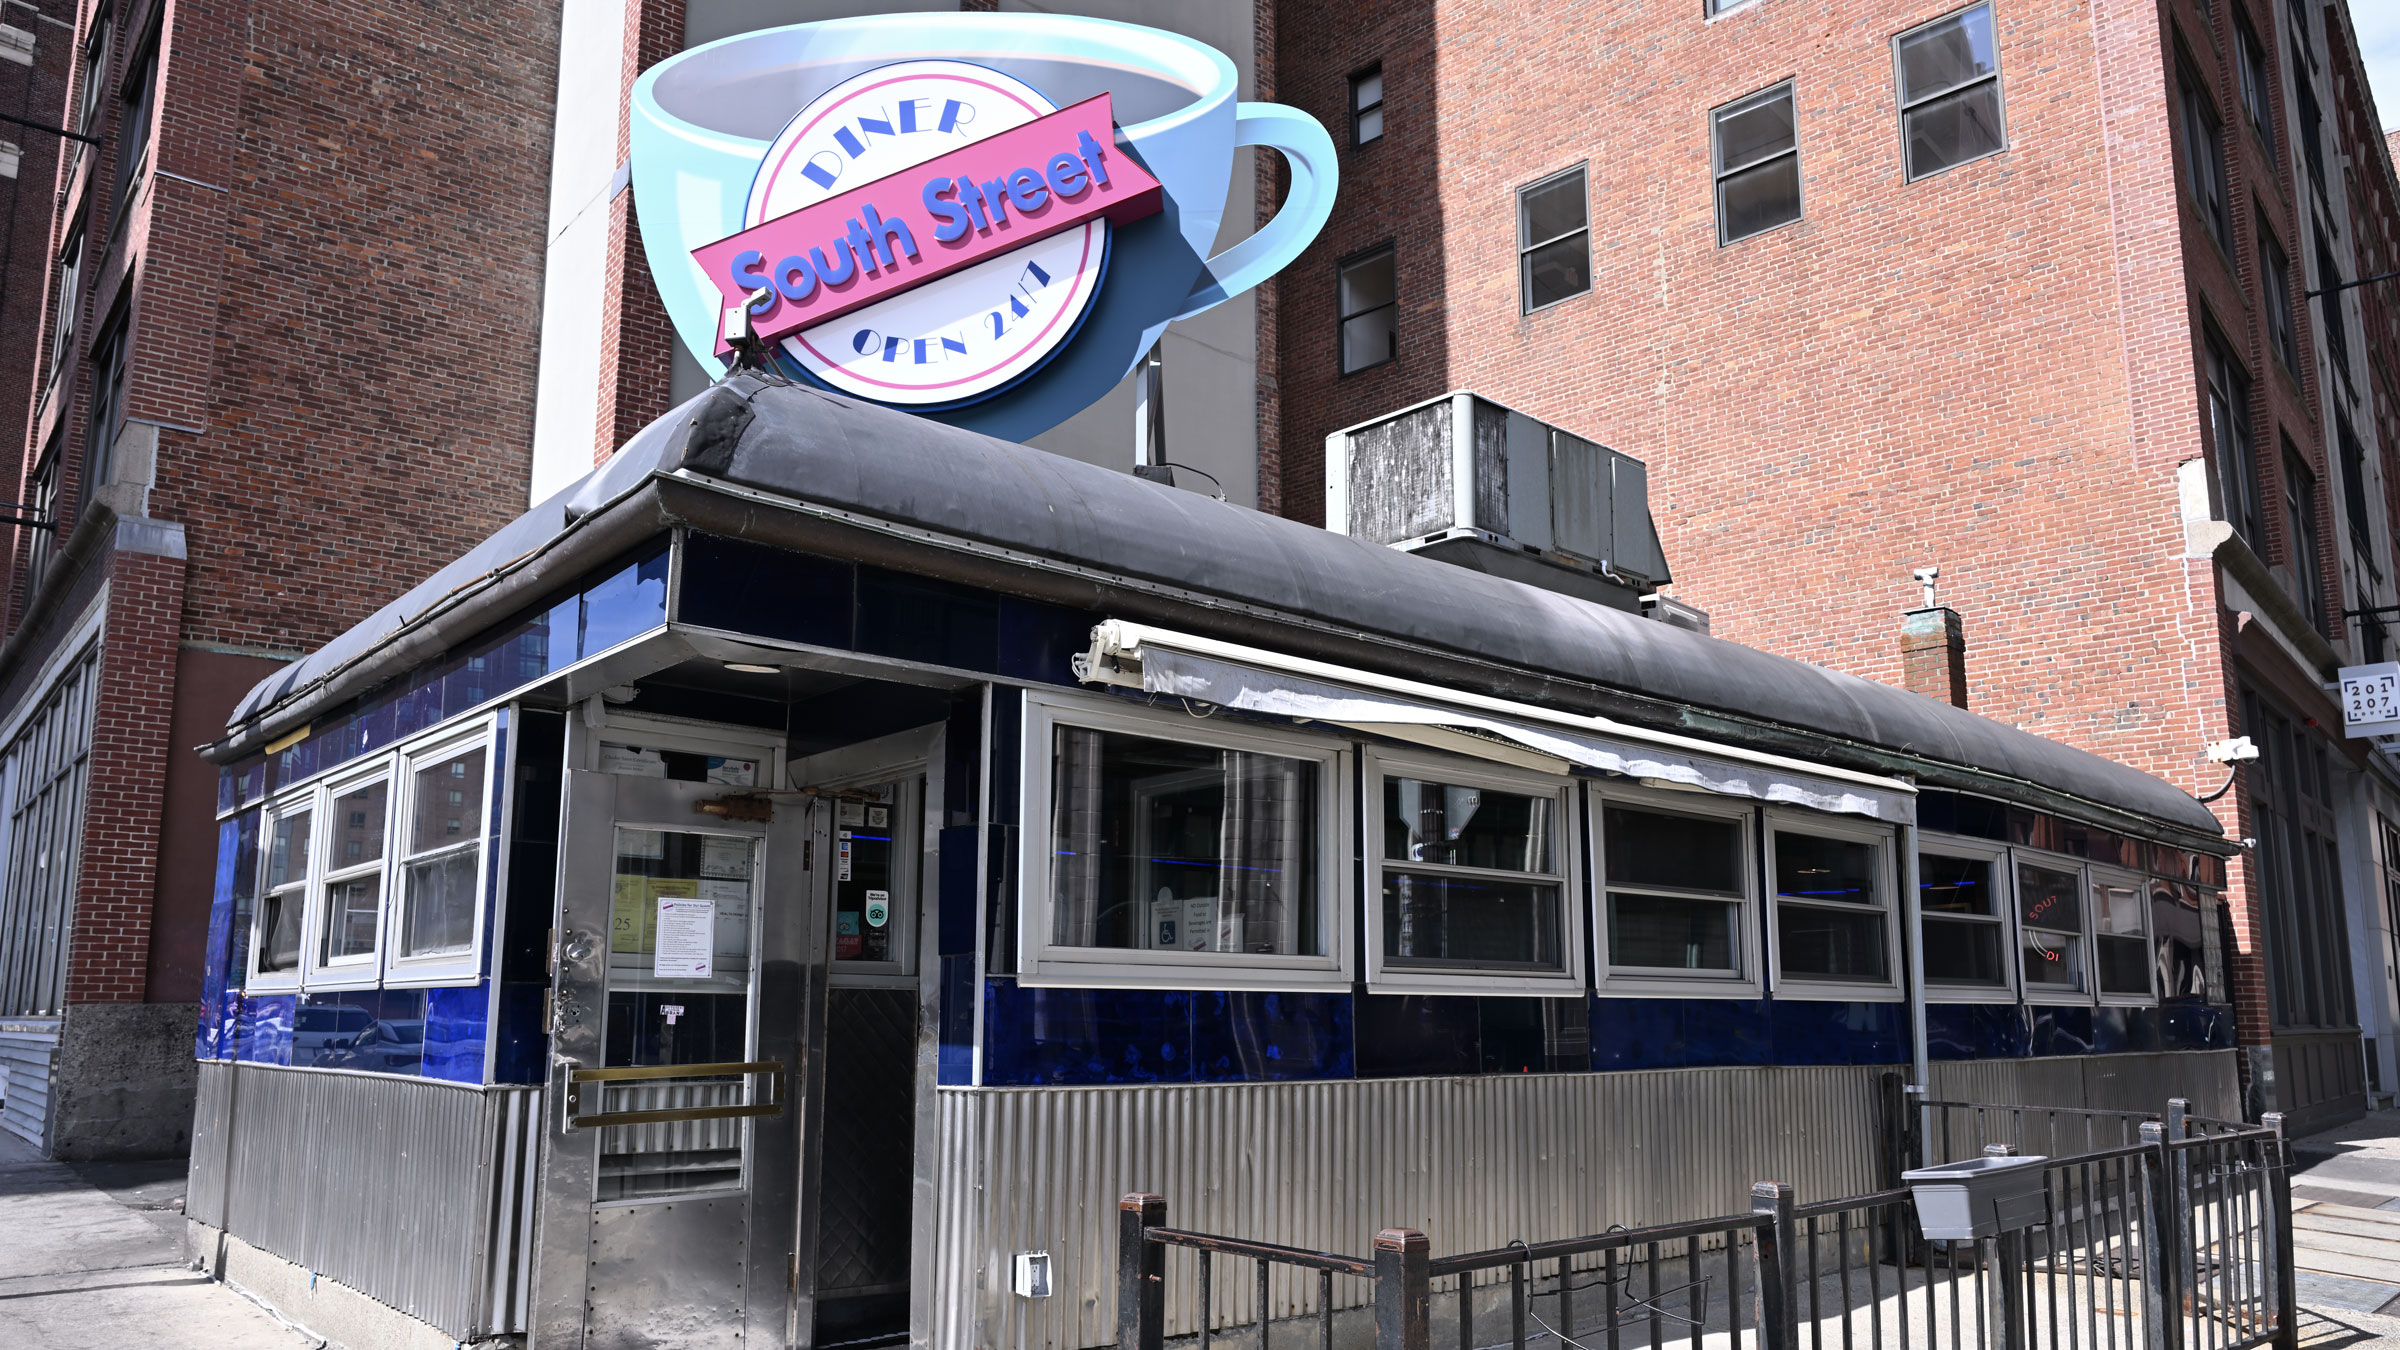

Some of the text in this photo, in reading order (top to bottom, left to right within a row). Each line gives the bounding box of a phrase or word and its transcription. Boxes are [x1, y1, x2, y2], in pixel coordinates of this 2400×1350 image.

[801, 97, 975, 190] DINER
[731, 129, 1109, 316] South Street
[852, 259, 1051, 365] OPEN 24/7
[2351, 683, 2389, 696] 201
[2354, 697, 2389, 710] 207
[613, 917, 631, 931] 25
